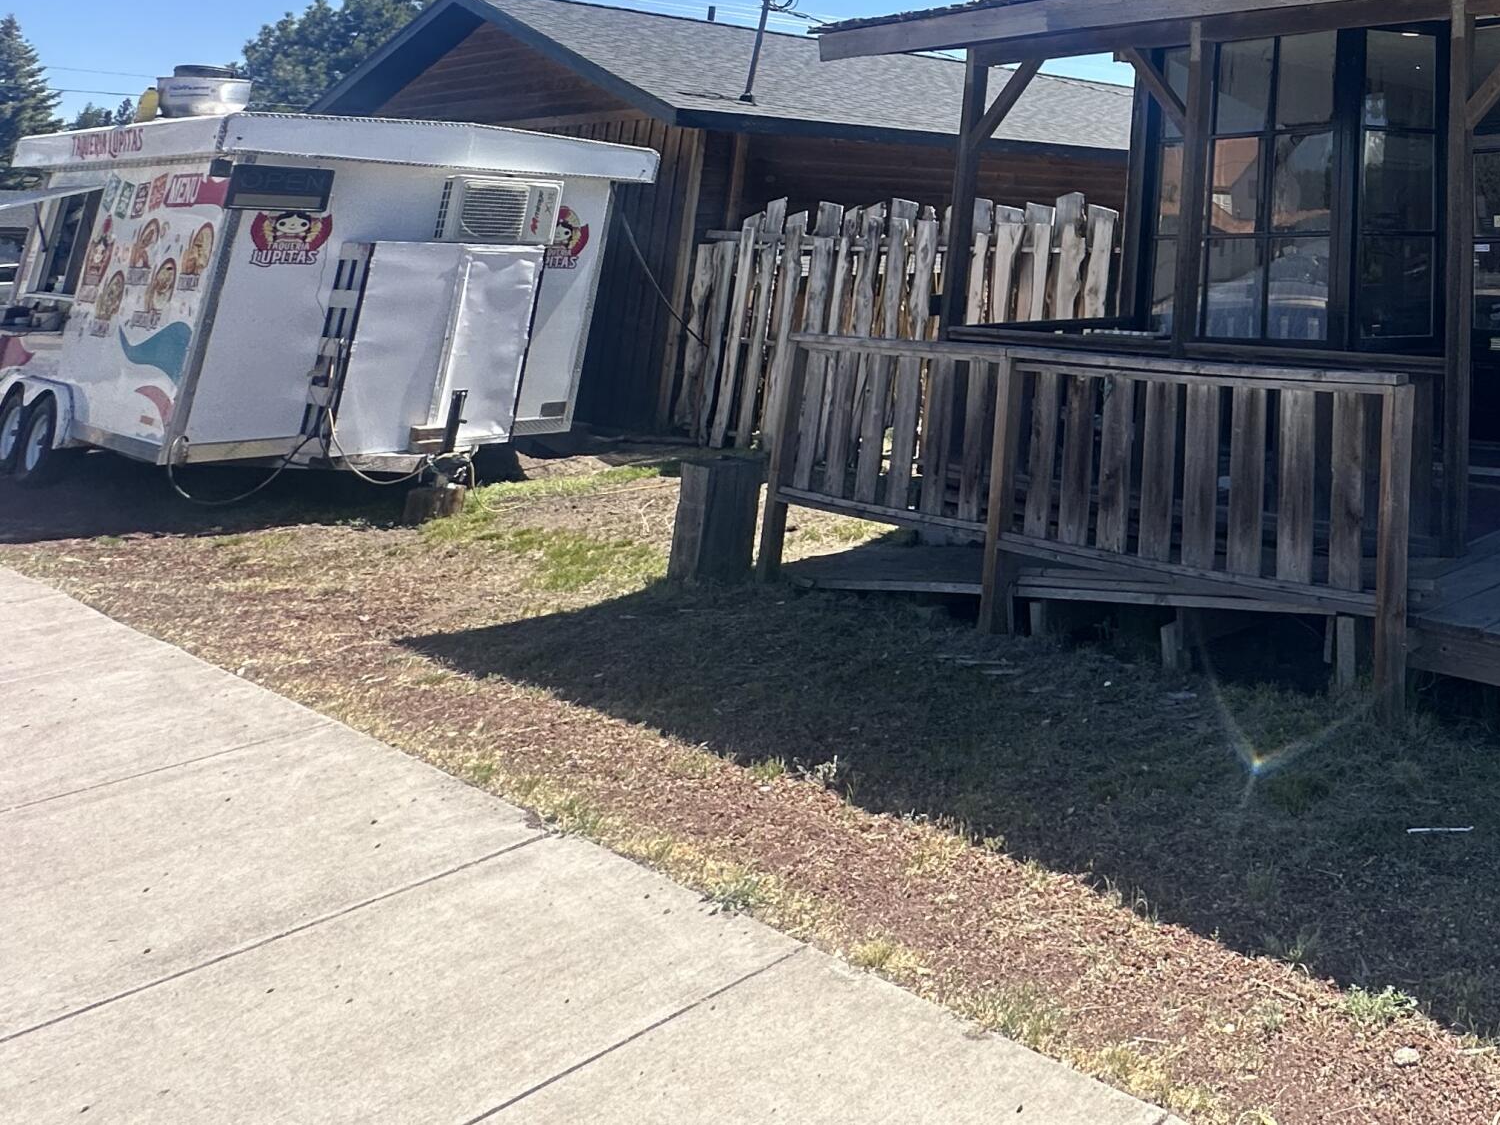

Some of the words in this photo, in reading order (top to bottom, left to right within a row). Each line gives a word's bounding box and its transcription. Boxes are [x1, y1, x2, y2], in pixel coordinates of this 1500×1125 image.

[72, 132, 107, 160] TAQUERIA
[108, 128, 144, 158] LUPITAS
[169, 175, 200, 204] MENU
[240, 170, 326, 191] OPEN
[267, 242, 311, 251] TAQUERIA
[249, 249, 319, 267] LUPITAS
[545, 256, 579, 269] PITAS
